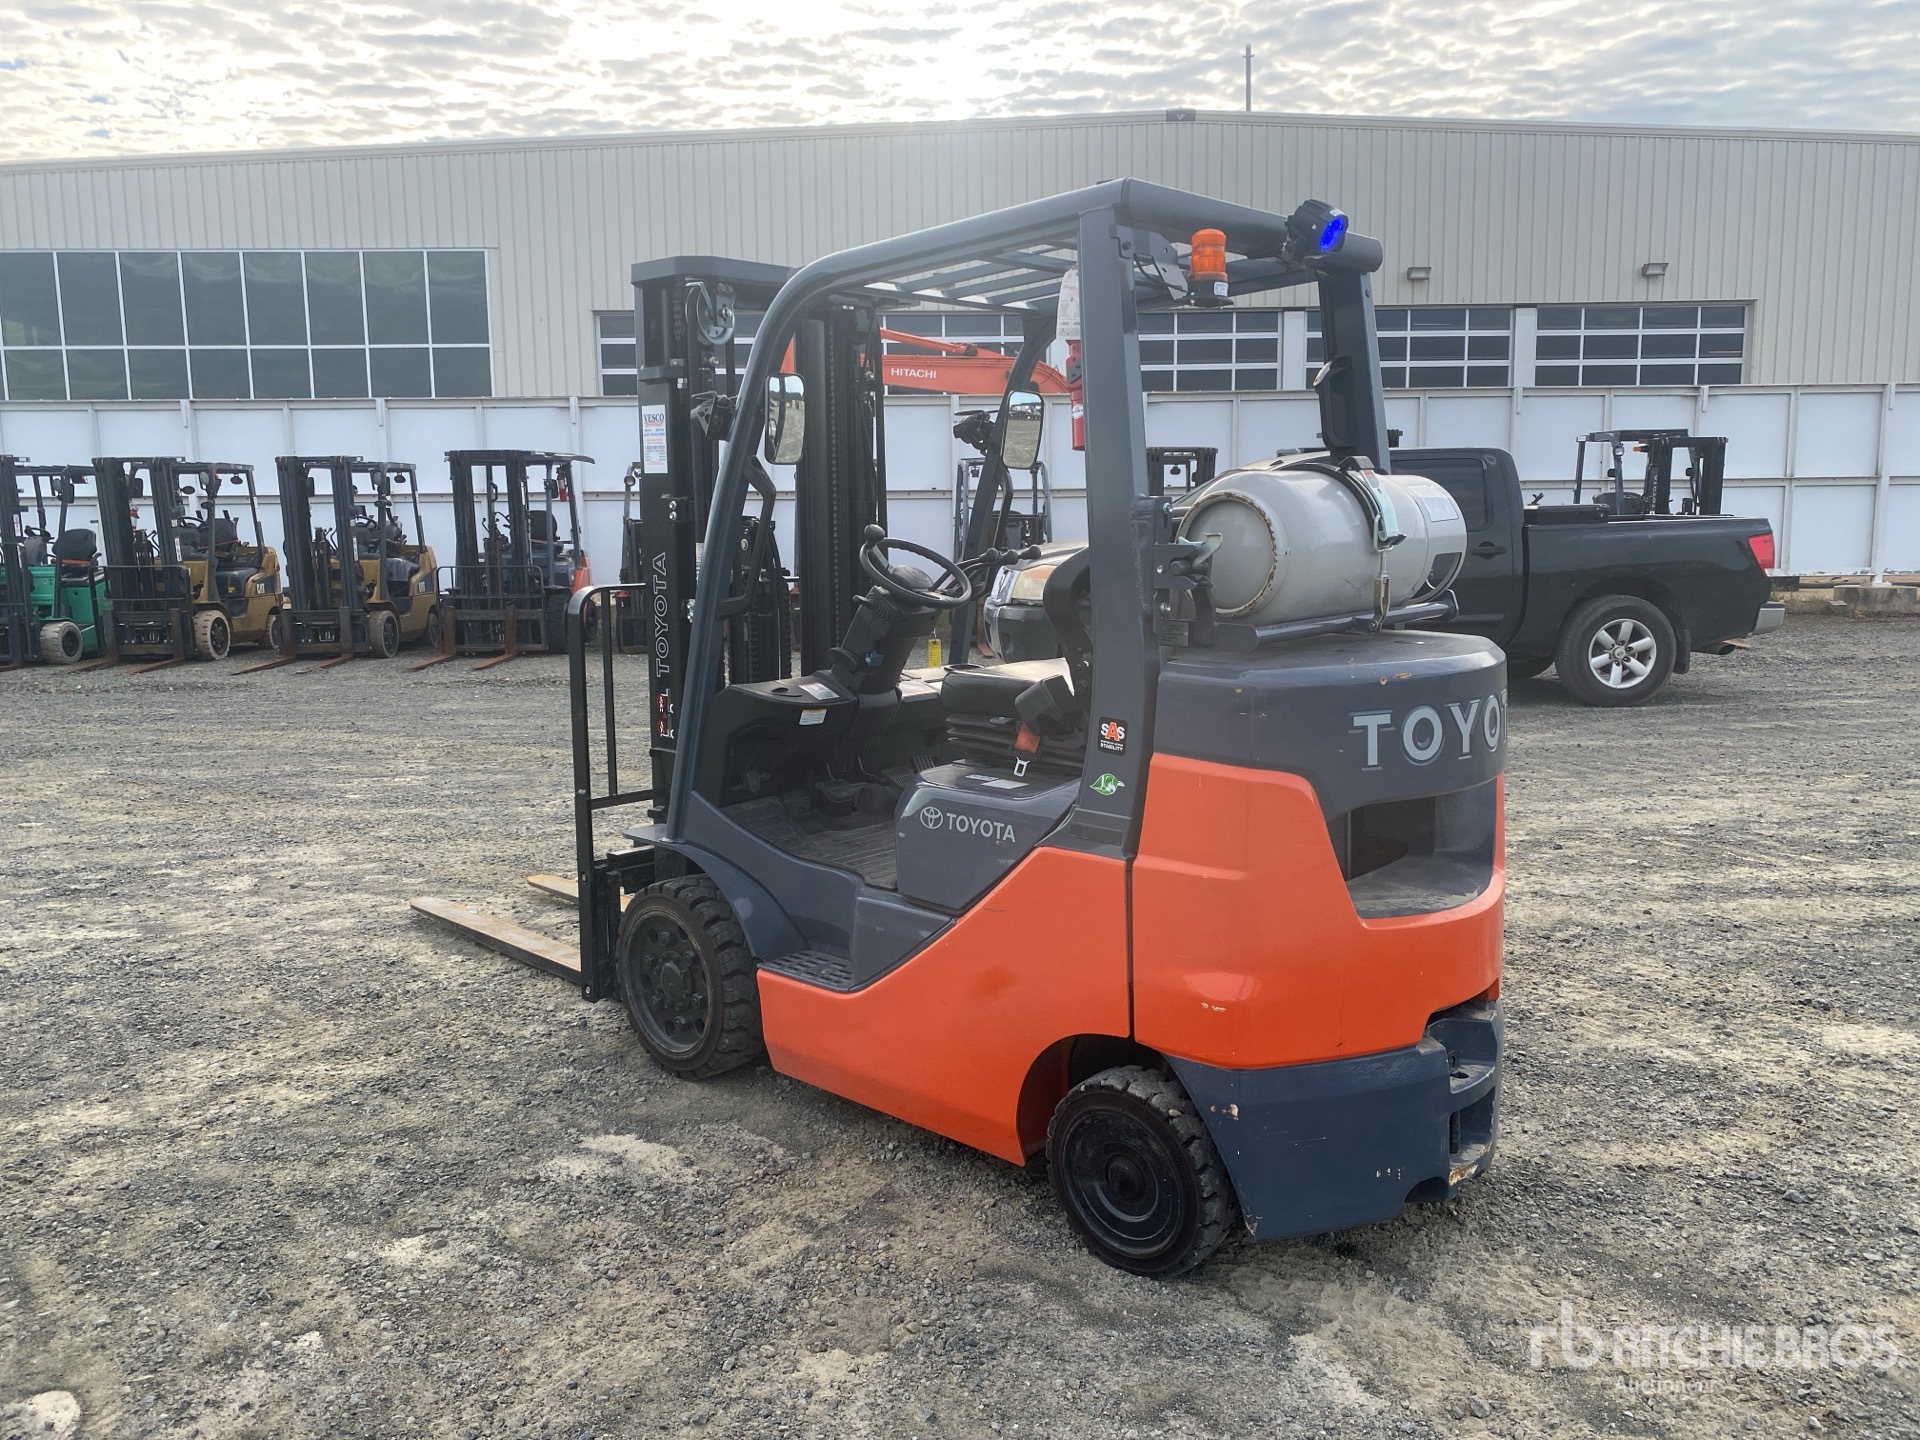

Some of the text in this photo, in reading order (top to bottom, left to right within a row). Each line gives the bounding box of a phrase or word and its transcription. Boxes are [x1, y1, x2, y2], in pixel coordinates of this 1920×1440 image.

[890, 367, 937, 379] HITACHI
[643, 412, 665, 423] VESCO
[652, 551, 671, 678] TOYOTA
[1100, 721, 1126, 742] SAS
[946, 812, 1016, 843] TOYOTA
